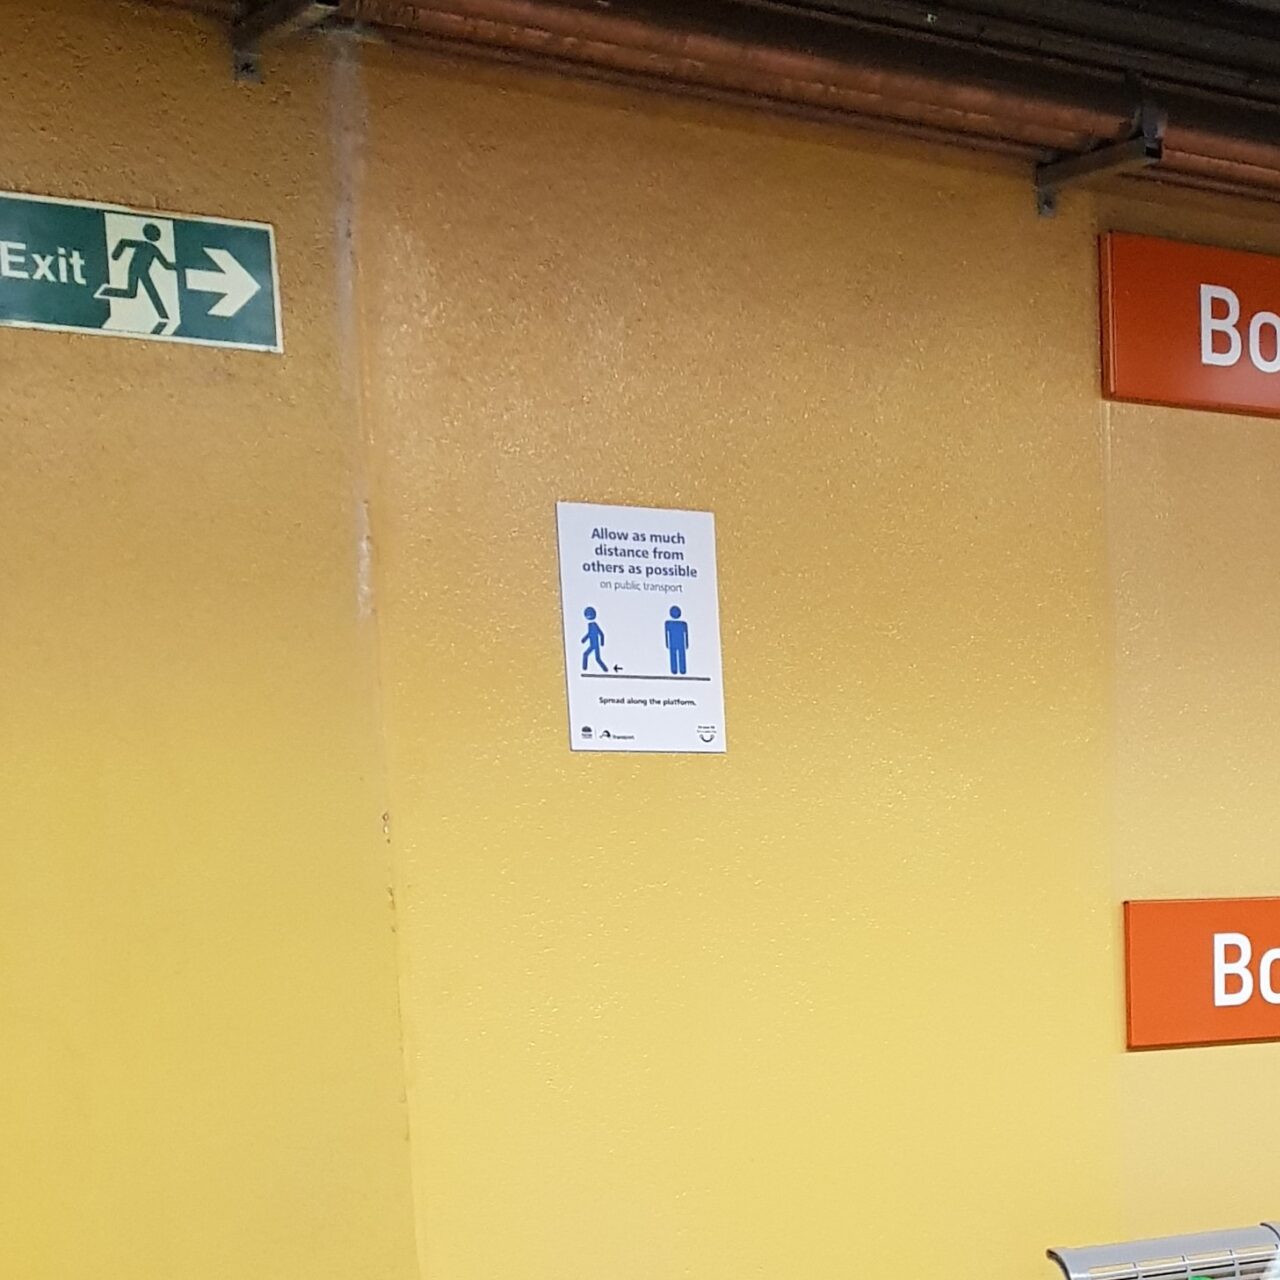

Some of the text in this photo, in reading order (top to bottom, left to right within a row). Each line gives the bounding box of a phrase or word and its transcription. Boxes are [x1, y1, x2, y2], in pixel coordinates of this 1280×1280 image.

[1, 241, 86, 285] Exit
[591, 527, 685, 545] Allow as much
[595, 543, 684, 560] distance from
[582, 560, 698, 578] others as possible
[600, 580, 683, 594] on public transport
[598, 697, 625, 706] Spread
[627, 697, 648, 706] along
[649, 697, 661, 706] the
